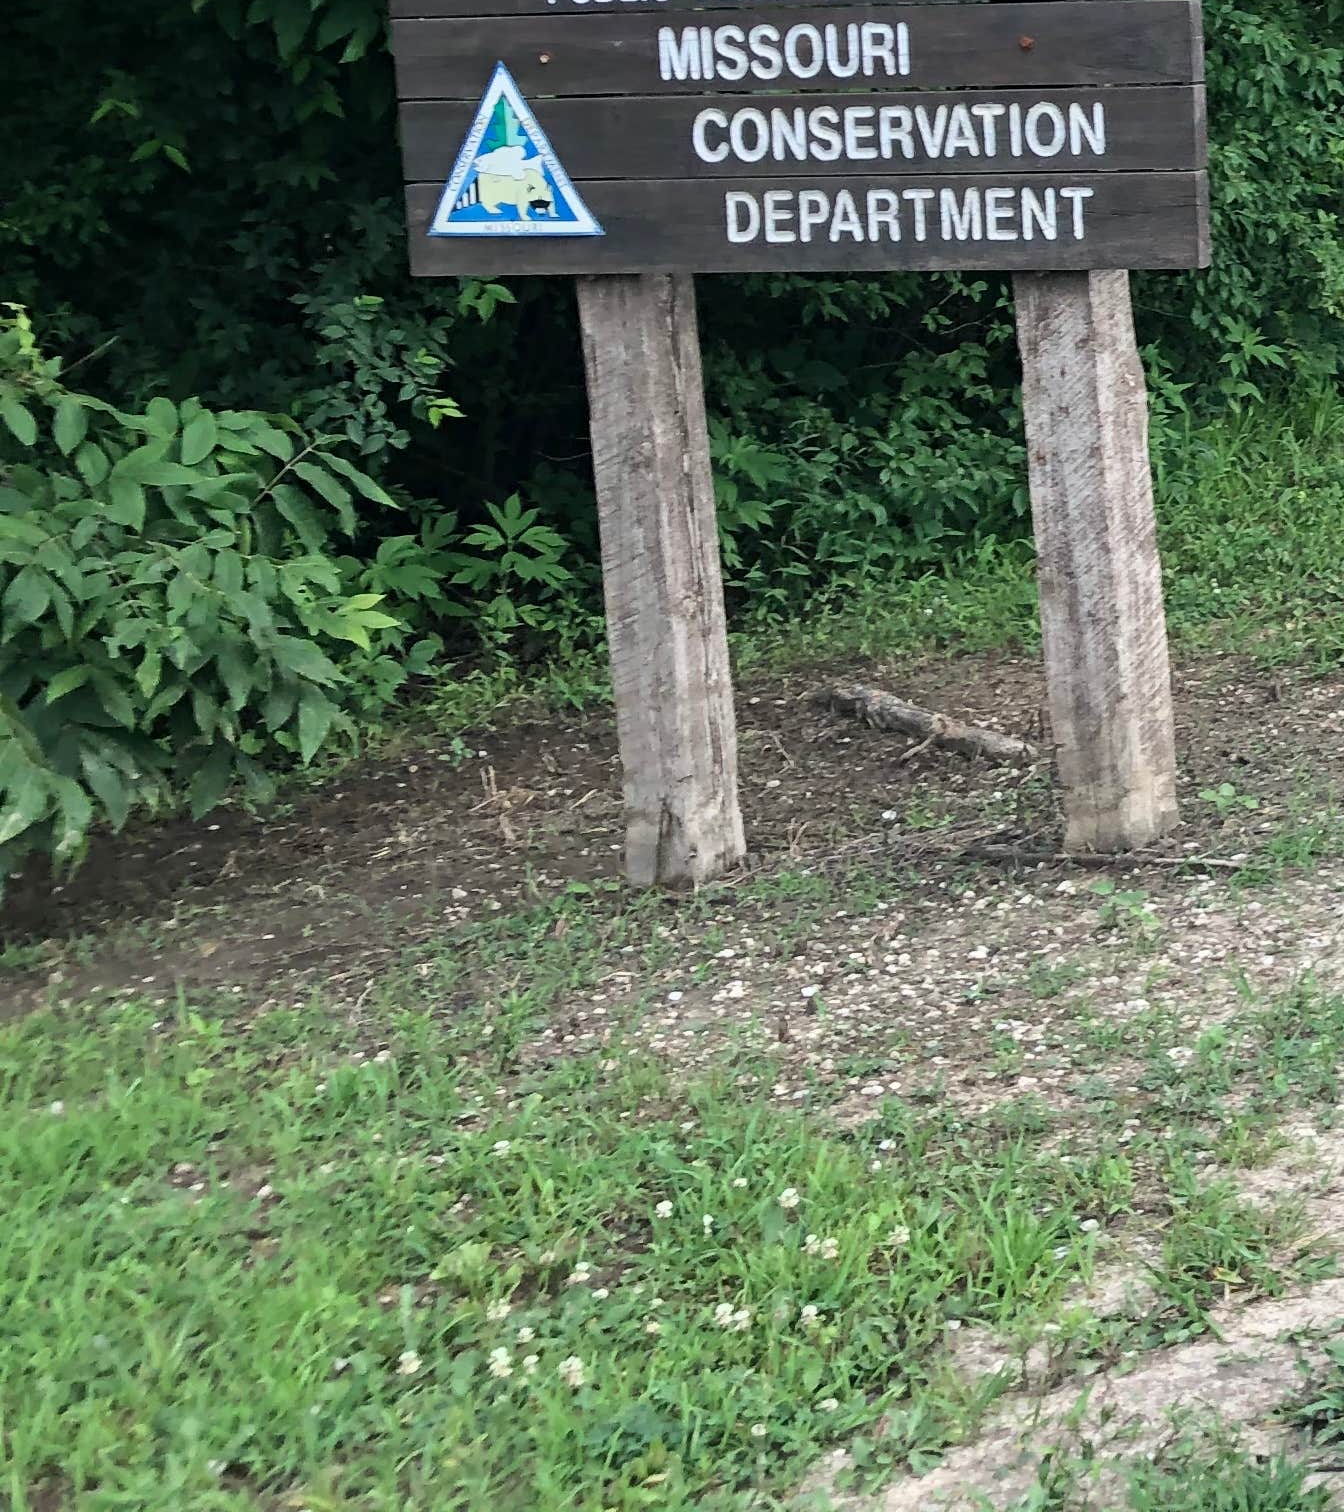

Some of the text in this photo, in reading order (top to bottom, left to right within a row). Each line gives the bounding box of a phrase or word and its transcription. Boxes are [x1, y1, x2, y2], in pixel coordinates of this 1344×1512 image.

[658, 21, 910, 81] MISSOURI
[692, 100, 1106, 163] CONSERVATION
[725, 186, 1094, 243] DEPARTMENT
